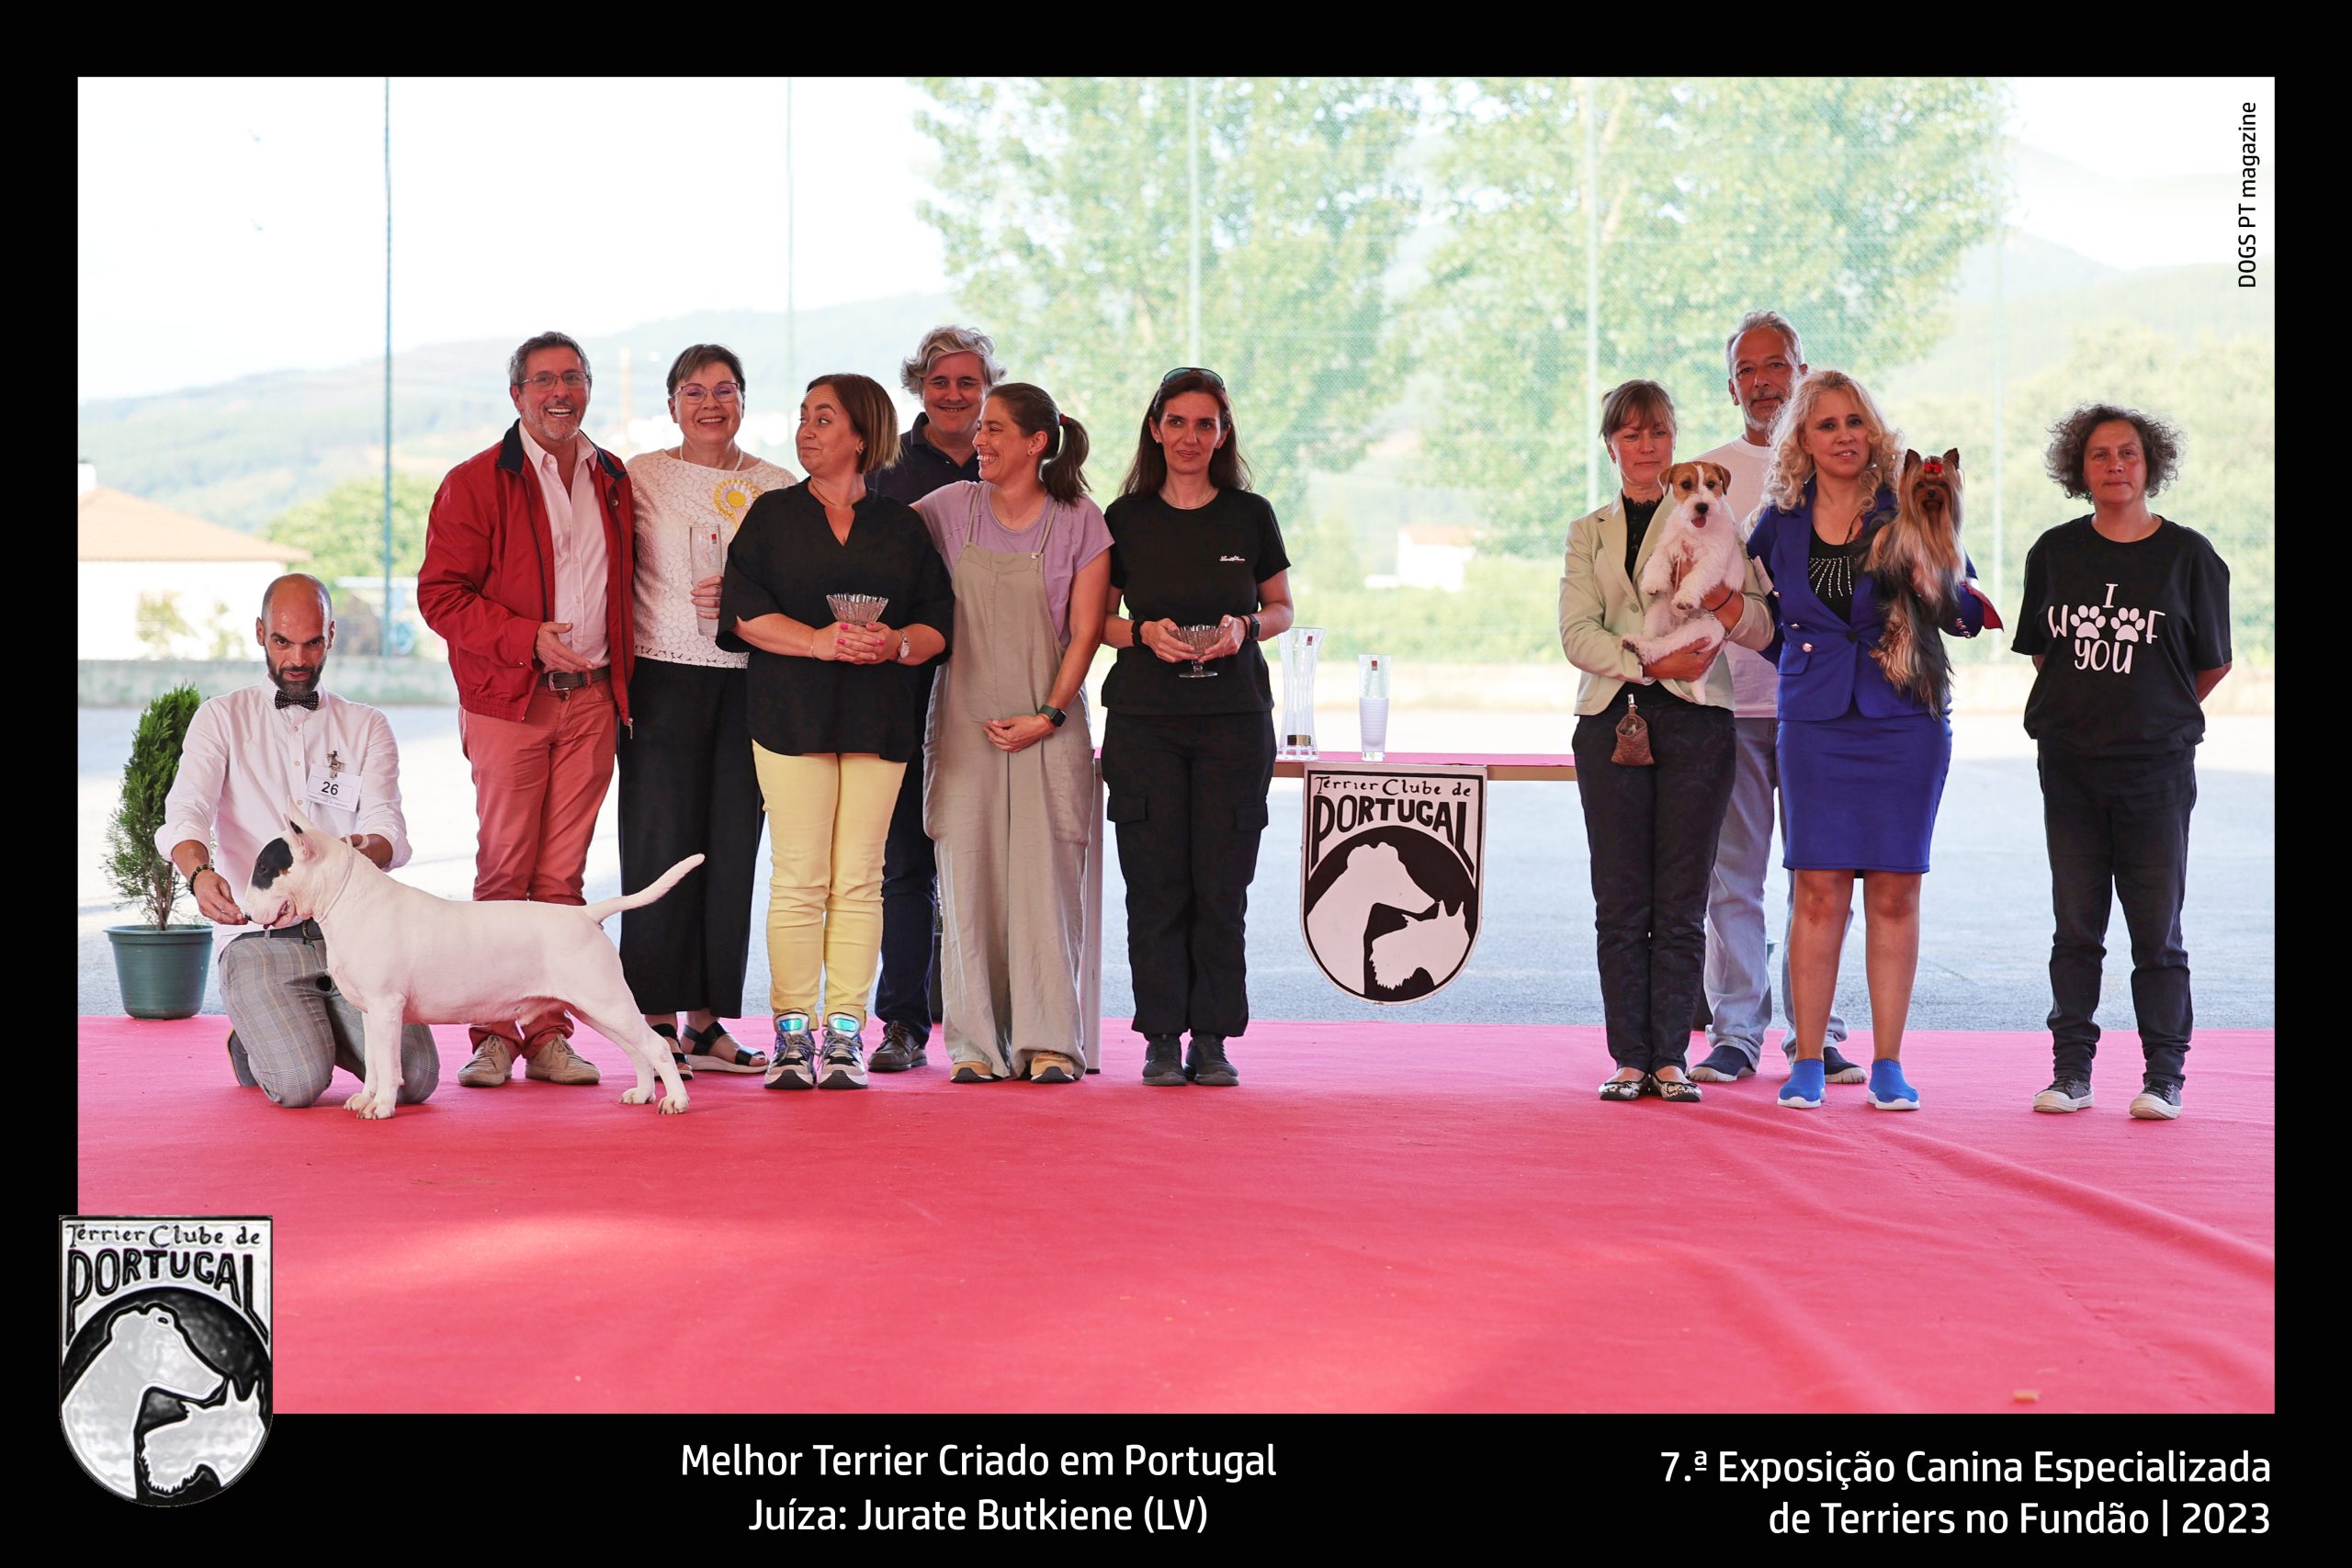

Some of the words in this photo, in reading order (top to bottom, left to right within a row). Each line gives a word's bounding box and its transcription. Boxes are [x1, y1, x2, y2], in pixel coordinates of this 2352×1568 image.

[2102, 582, 2119, 608] I
[321, 781, 339, 795] 26
[1314, 775, 1379, 795] Terrier
[1382, 778, 1442, 796] Clube
[1452, 782, 1471, 797] de
[1310, 794, 1475, 879] PORTUGAL
